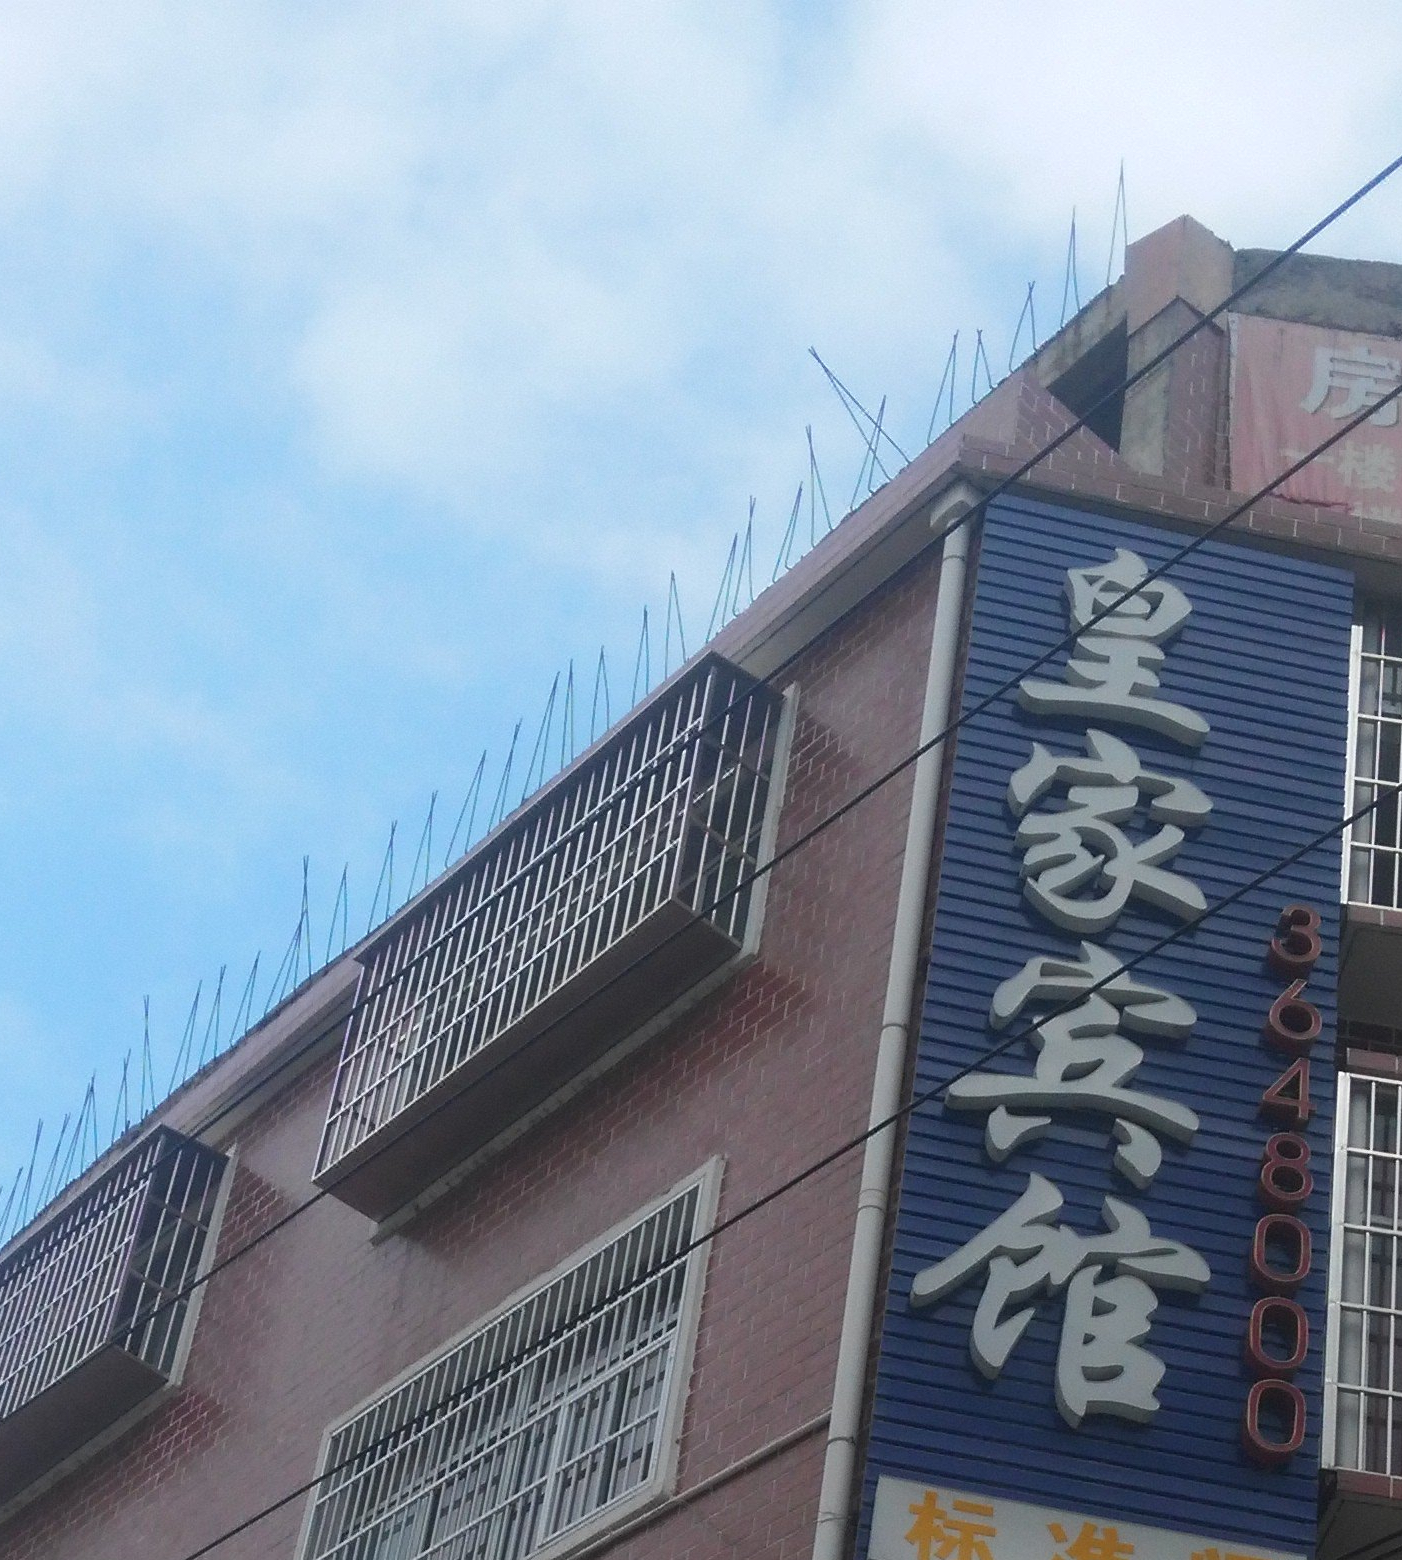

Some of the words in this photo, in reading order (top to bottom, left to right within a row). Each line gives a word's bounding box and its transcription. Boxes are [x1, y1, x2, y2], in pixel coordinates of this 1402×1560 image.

[910, 548, 1211, 1429] 皇家宾馆
[1242, 905, 1321, 1466] 3648000
